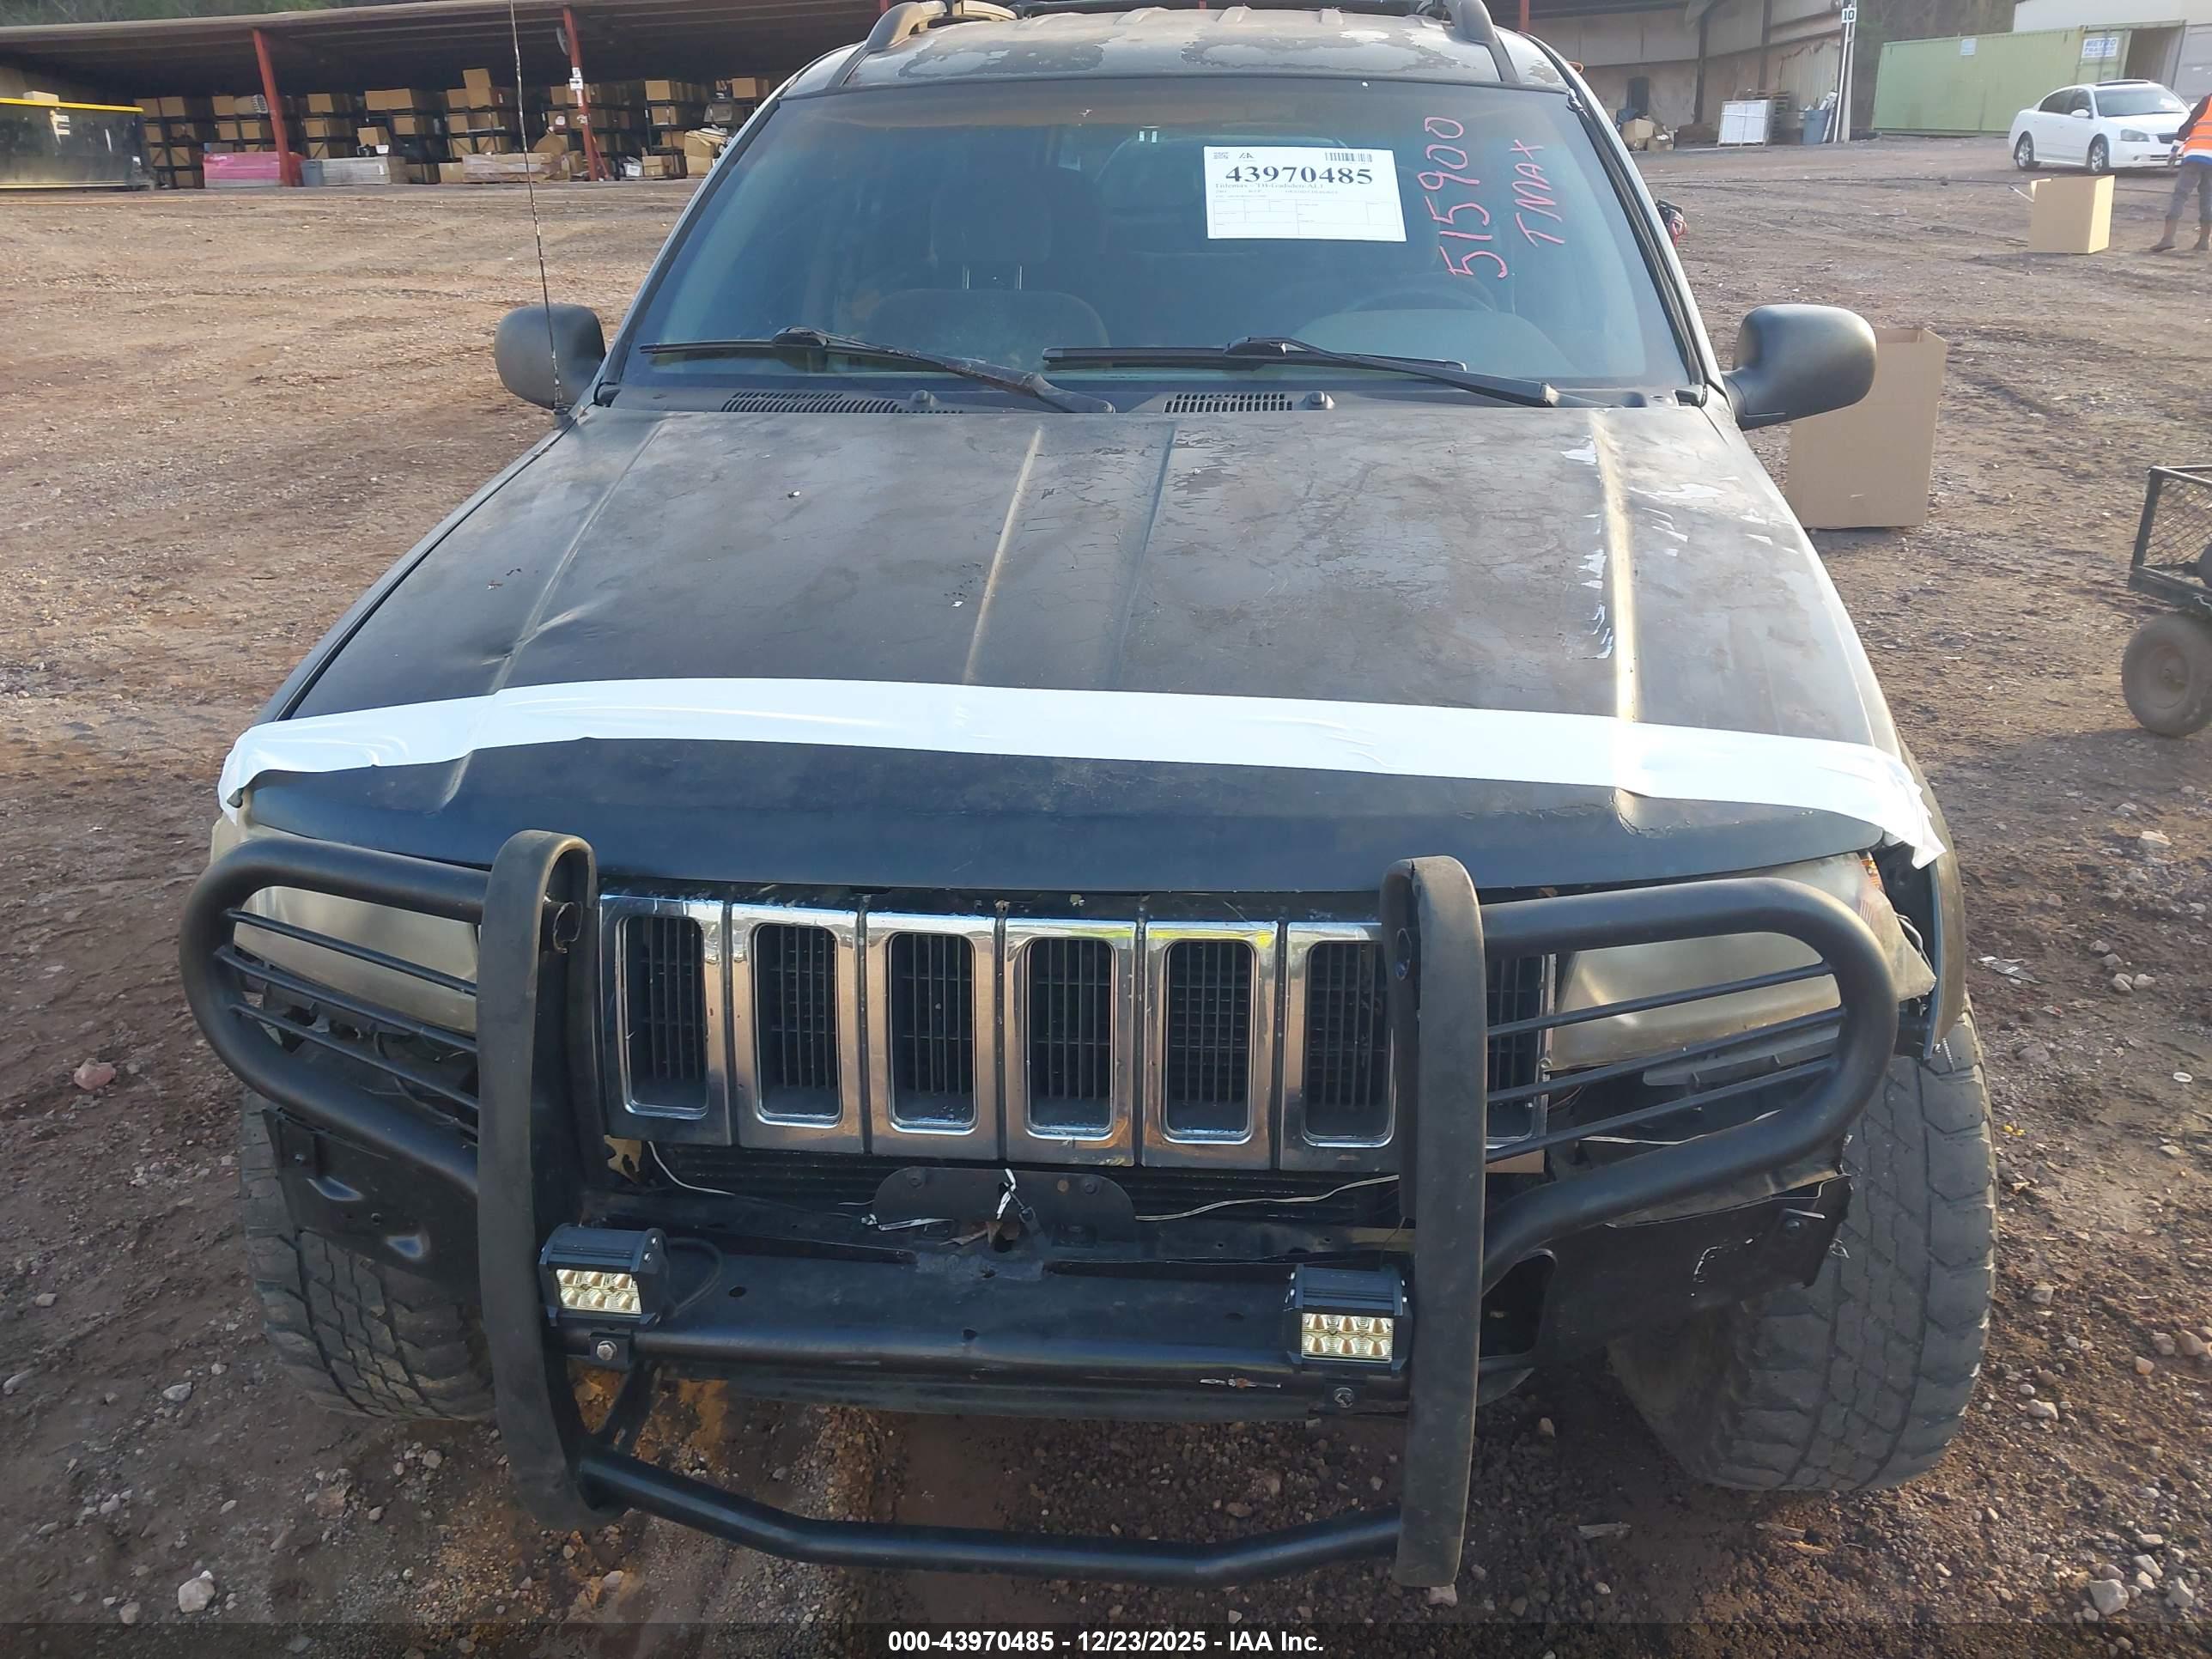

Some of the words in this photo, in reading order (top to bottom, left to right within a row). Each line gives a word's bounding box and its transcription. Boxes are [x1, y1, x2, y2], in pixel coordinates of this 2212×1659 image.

[1844, 9, 1855, 21] 10
[1225, 166, 1373, 185] 43970485
[1417, 116, 1508, 278] 515900
[1509, 139, 1566, 247] TMAX
